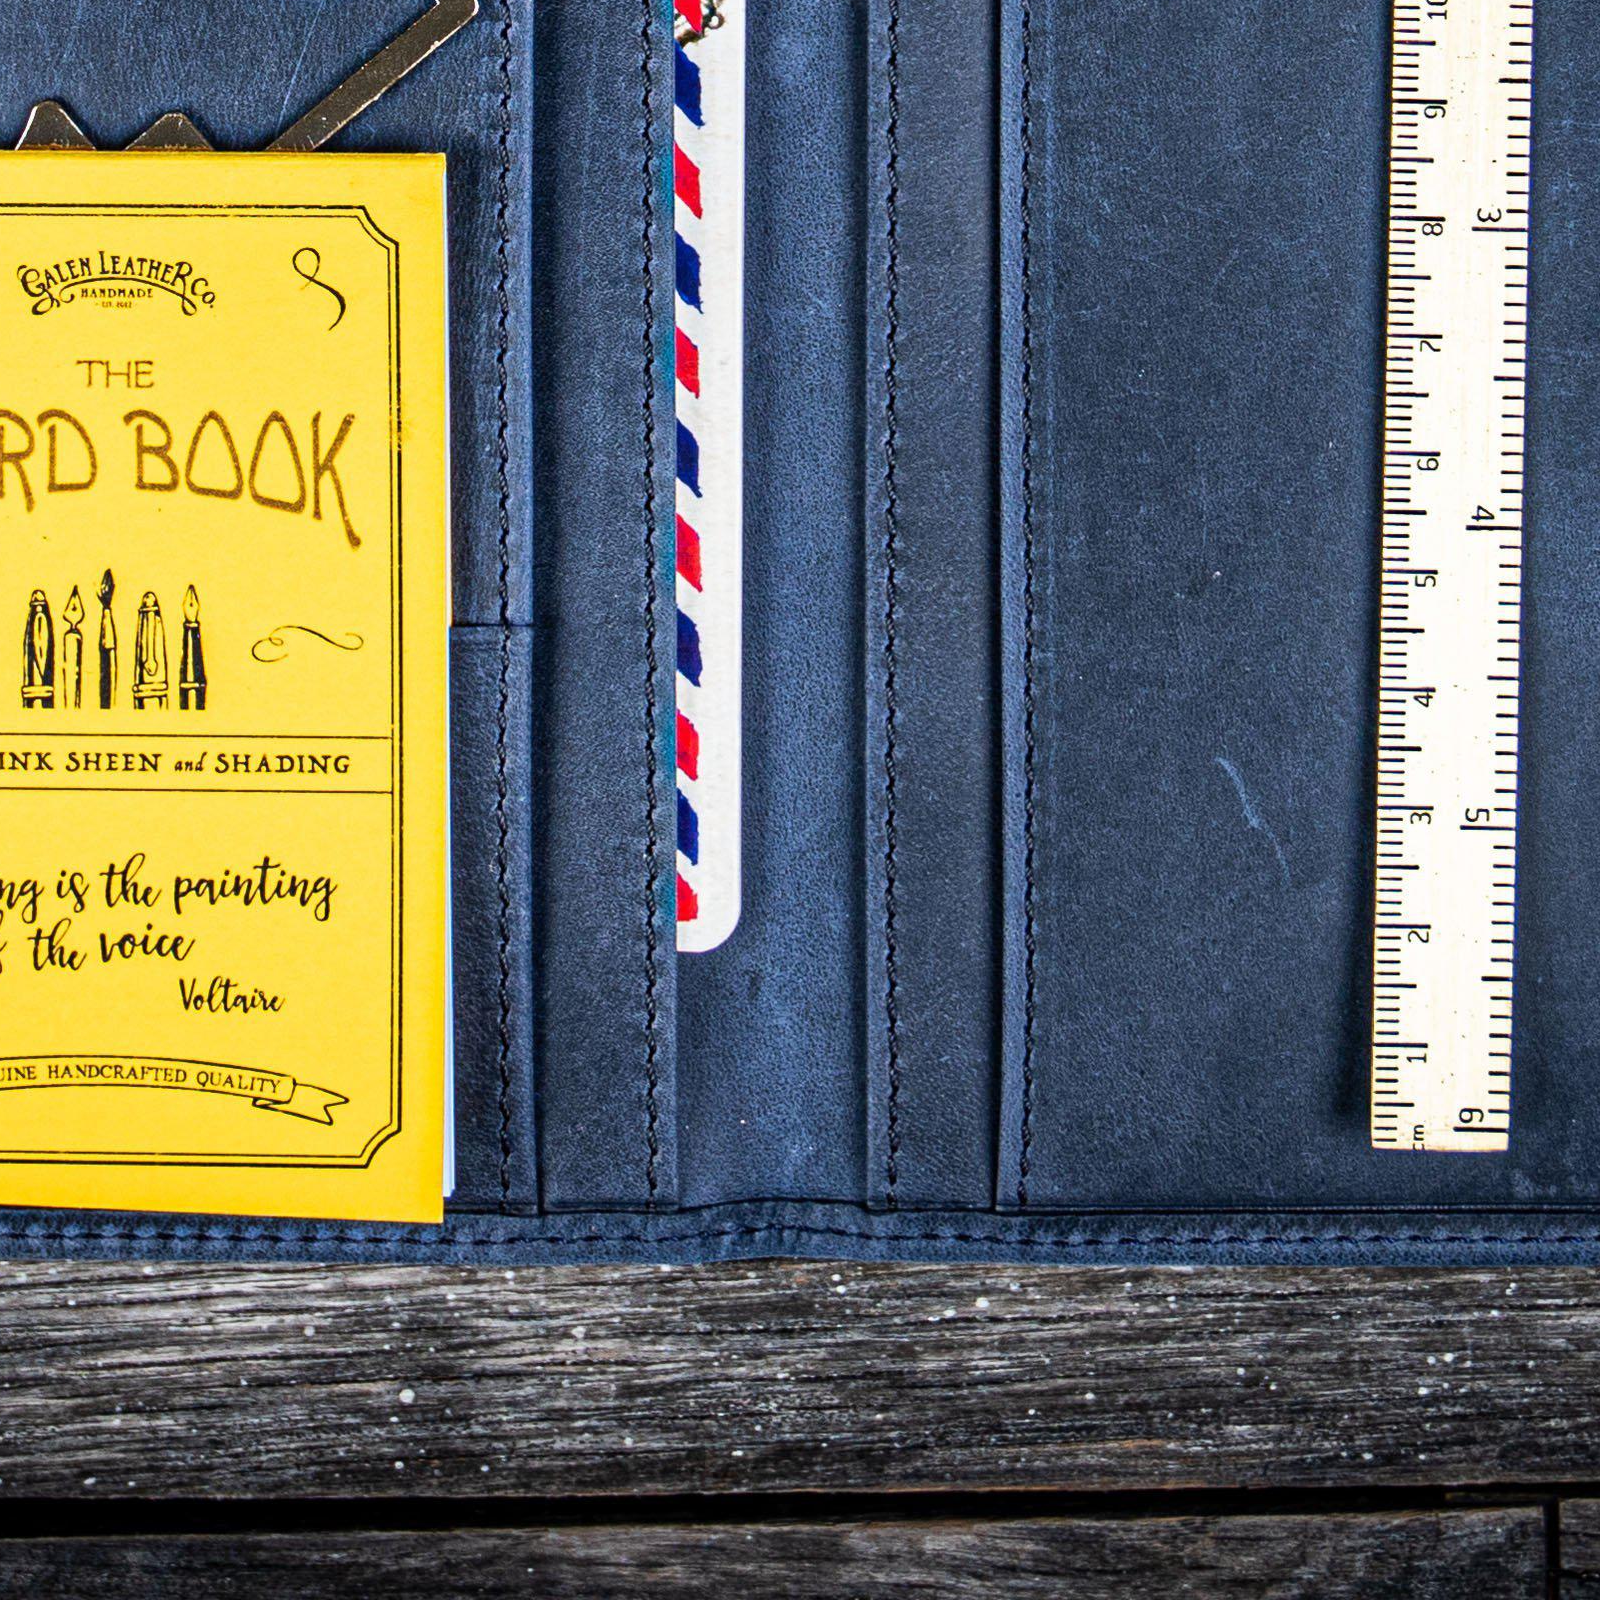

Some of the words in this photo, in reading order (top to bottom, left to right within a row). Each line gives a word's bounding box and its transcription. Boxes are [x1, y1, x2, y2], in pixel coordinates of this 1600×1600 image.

[1423, 104, 1446, 120] 9
[1476, 206, 1502, 223] 3
[1421, 221, 1444, 237] 8
[16, 257, 91, 316] GALEN
[98, 250, 197, 317] LEATHER
[80, 287, 154, 299] HANDMADE
[1419, 339, 1442, 353] 7
[75, 358, 155, 390] THE
[1416, 456, 1439, 472] 6
[122, 407, 363, 551] BOOK
[1470, 504, 1496, 522] 4
[1414, 574, 1437, 588] 5
[1412, 690, 1434, 708] 4
[64, 751, 163, 773] SHEEN
[173, 751, 206, 774] and
[213, 751, 352, 775] SHADING
[1409, 811, 1432, 825] 3
[1464, 807, 1491, 823] 5
[55, 868, 91, 914] is
[99, 851, 163, 910] the
[172, 855, 339, 922] painting
[27, 917, 89, 974] the
[99, 921, 196, 963] voice
[1407, 930, 1430, 944] 2
[177, 974, 286, 1014] Voltaire
[1405, 1052, 1427, 1064] 1
[46, 1062, 189, 1085] HANDCRAFTED
[195, 1068, 283, 1096] QUALITY
[1458, 1106, 1485, 1124] 6
[1412, 1123, 1426, 1151] cm
